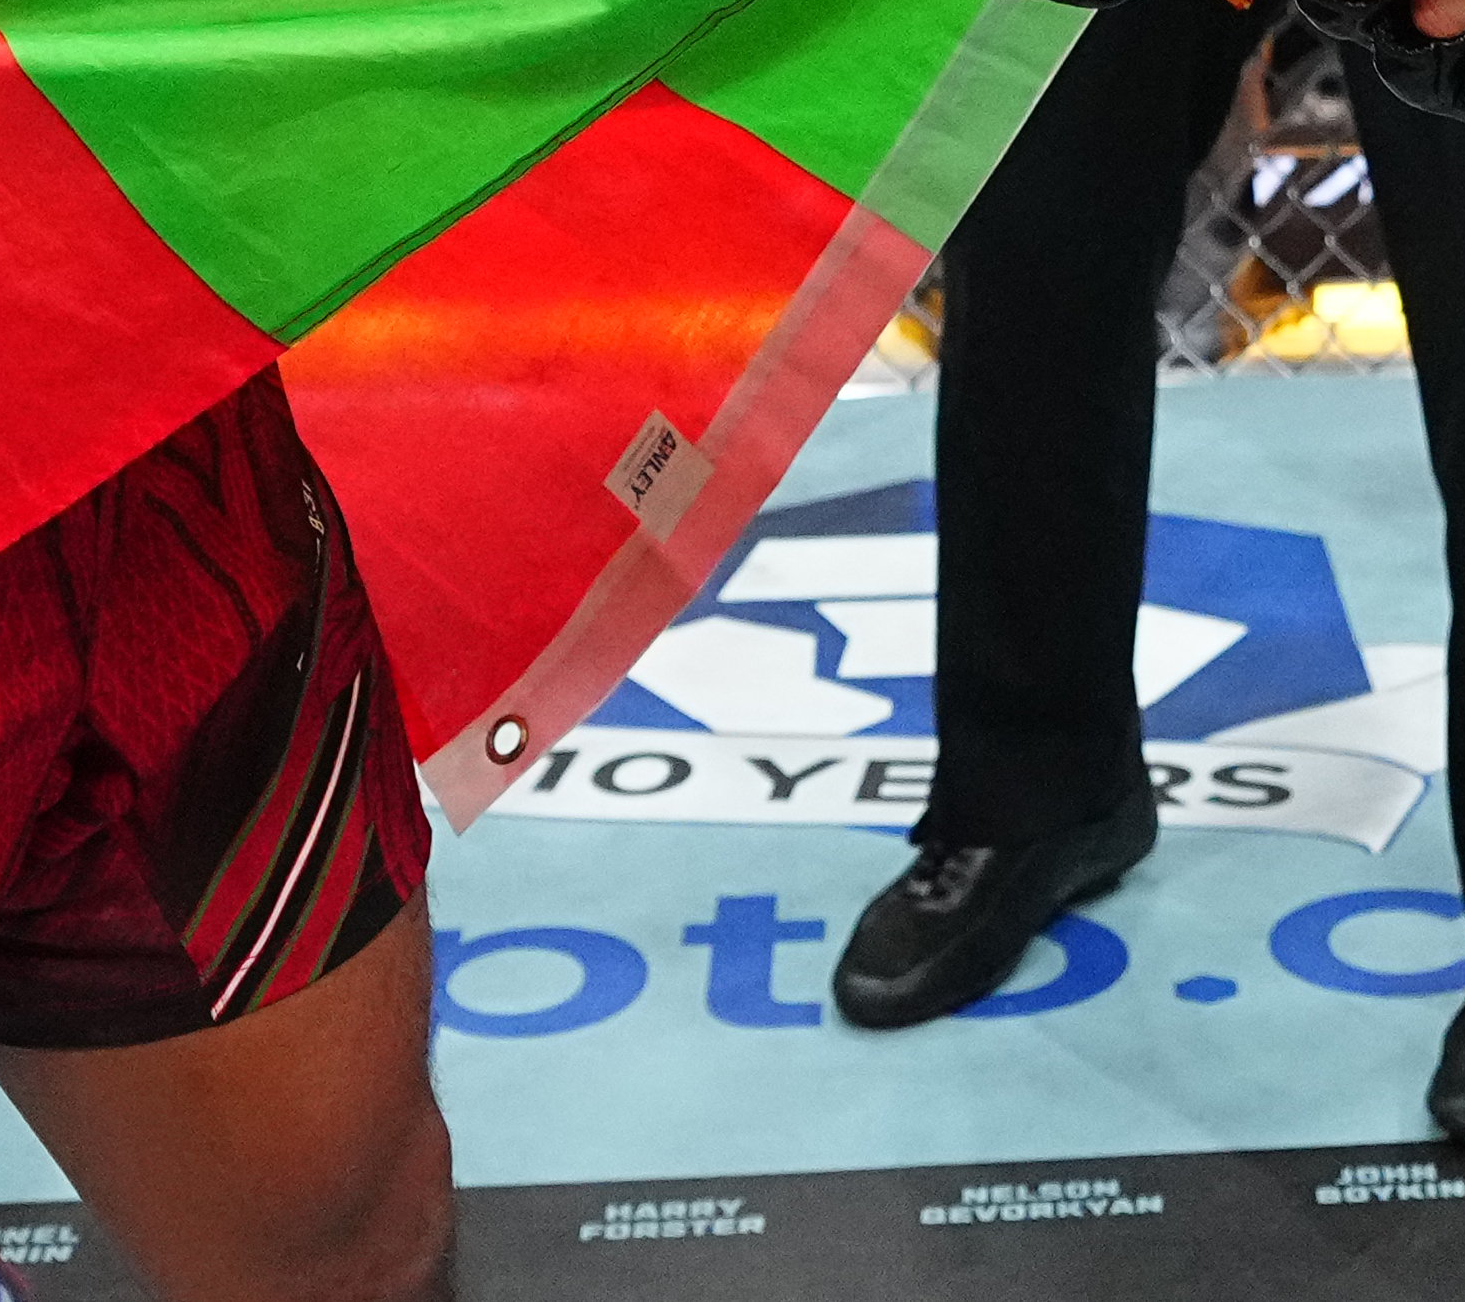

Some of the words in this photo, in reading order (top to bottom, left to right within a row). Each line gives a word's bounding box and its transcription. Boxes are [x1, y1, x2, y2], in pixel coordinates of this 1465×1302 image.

[746, 756, 1293, 809] YERS
[1337, 1163, 1437, 1186] JOHN
[961, 1179, 1121, 1204] NELSON
[604, 1198, 746, 1224] HARRY
[579, 1216, 766, 1243] FORSTER
